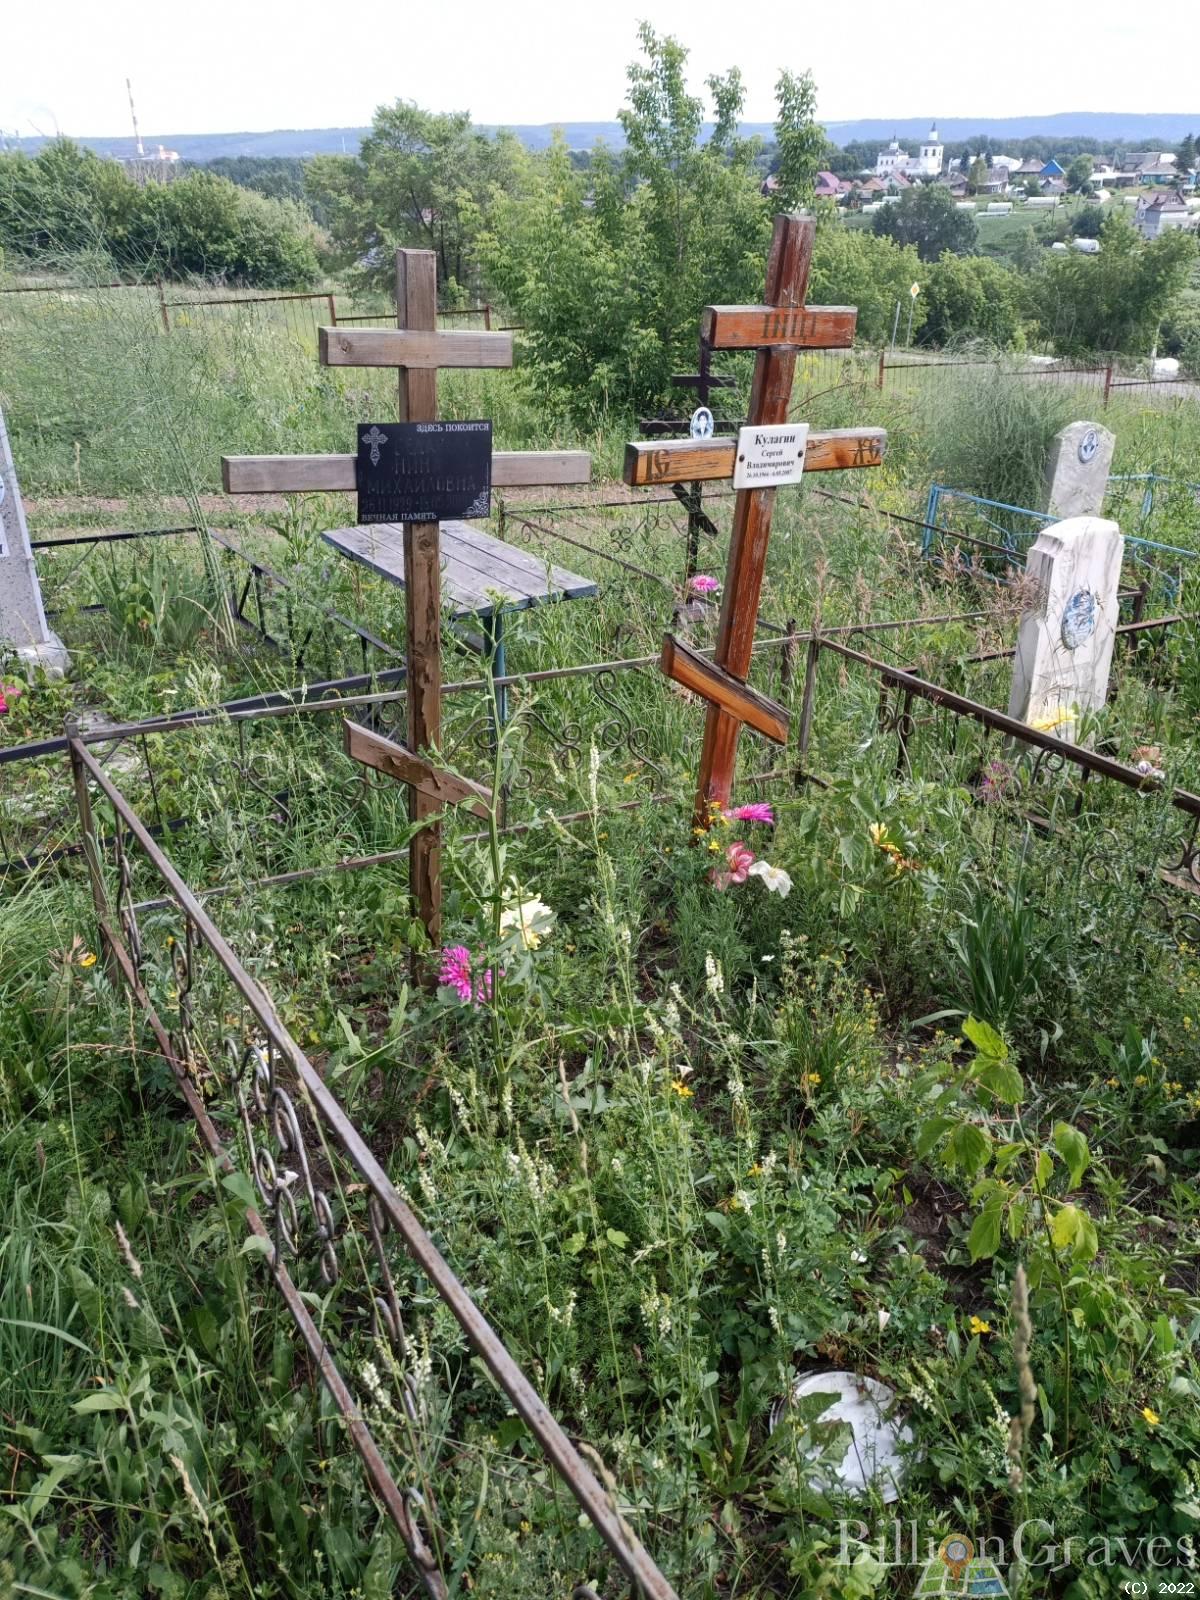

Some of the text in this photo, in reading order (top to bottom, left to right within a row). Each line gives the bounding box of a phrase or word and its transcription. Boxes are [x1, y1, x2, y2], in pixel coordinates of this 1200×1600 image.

[416, 422, 490, 433] ЗДЕСЬ ПОКОИТСЯ
[755, 434, 796, 447] Кулагин
[761, 449, 784, 459] Сергей
[746, 459, 795, 470] Владимирович
[361, 511, 438, 522] ВЕЧНАЯ ПАМЯТЬ
